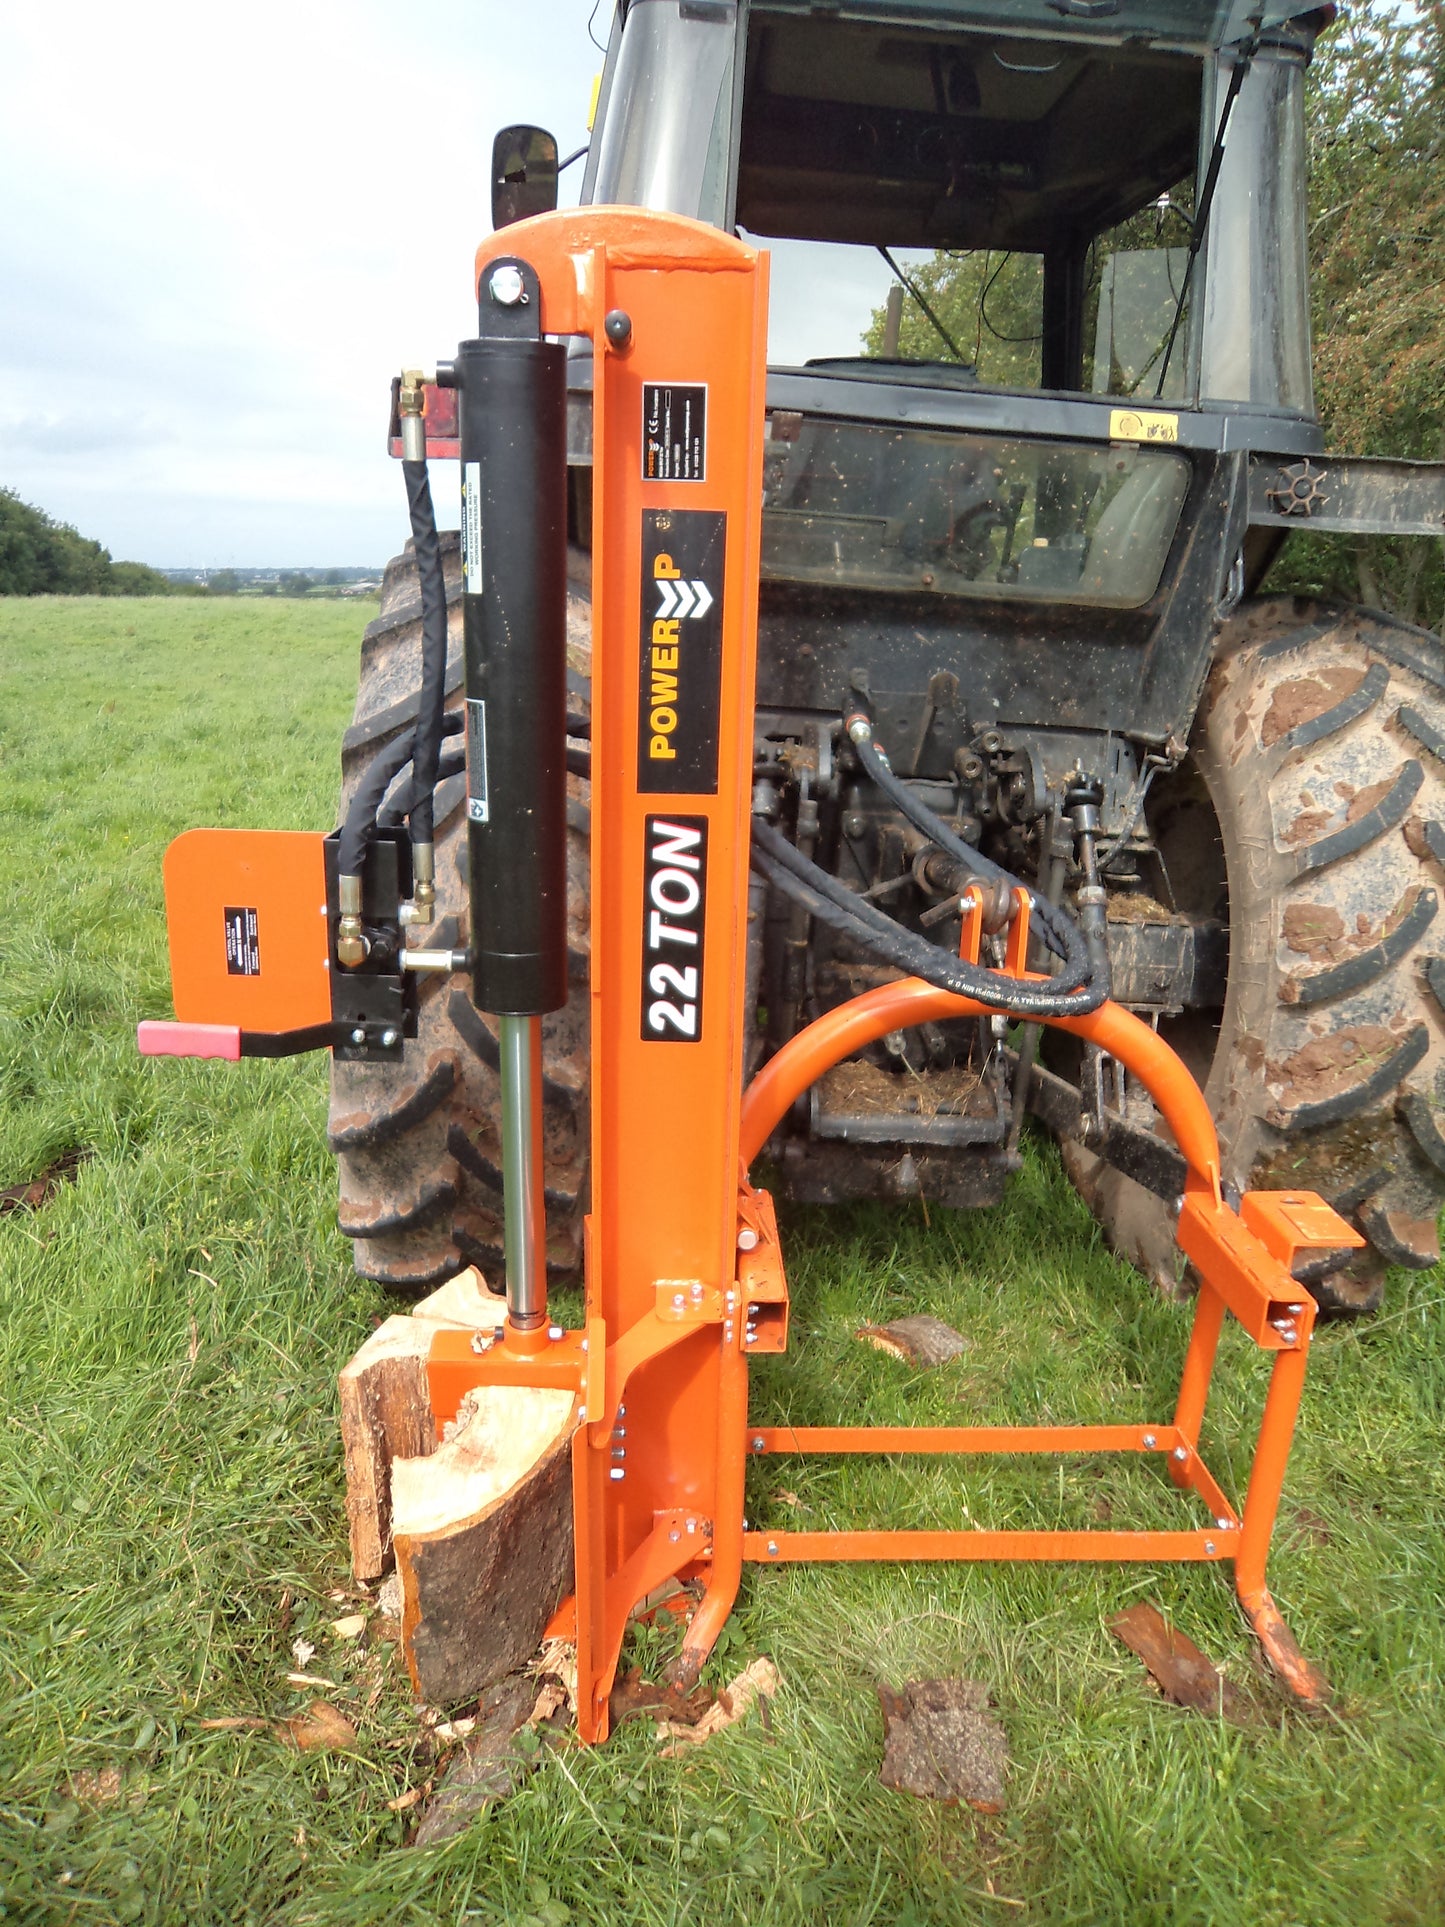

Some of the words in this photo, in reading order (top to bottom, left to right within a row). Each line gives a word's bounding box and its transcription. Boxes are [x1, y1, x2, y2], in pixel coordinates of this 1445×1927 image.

[649, 619, 680, 759] POWER
[649, 819, 702, 949] TON
[648, 962, 698, 1036] 22
[961, 983, 975, 993] MIN
